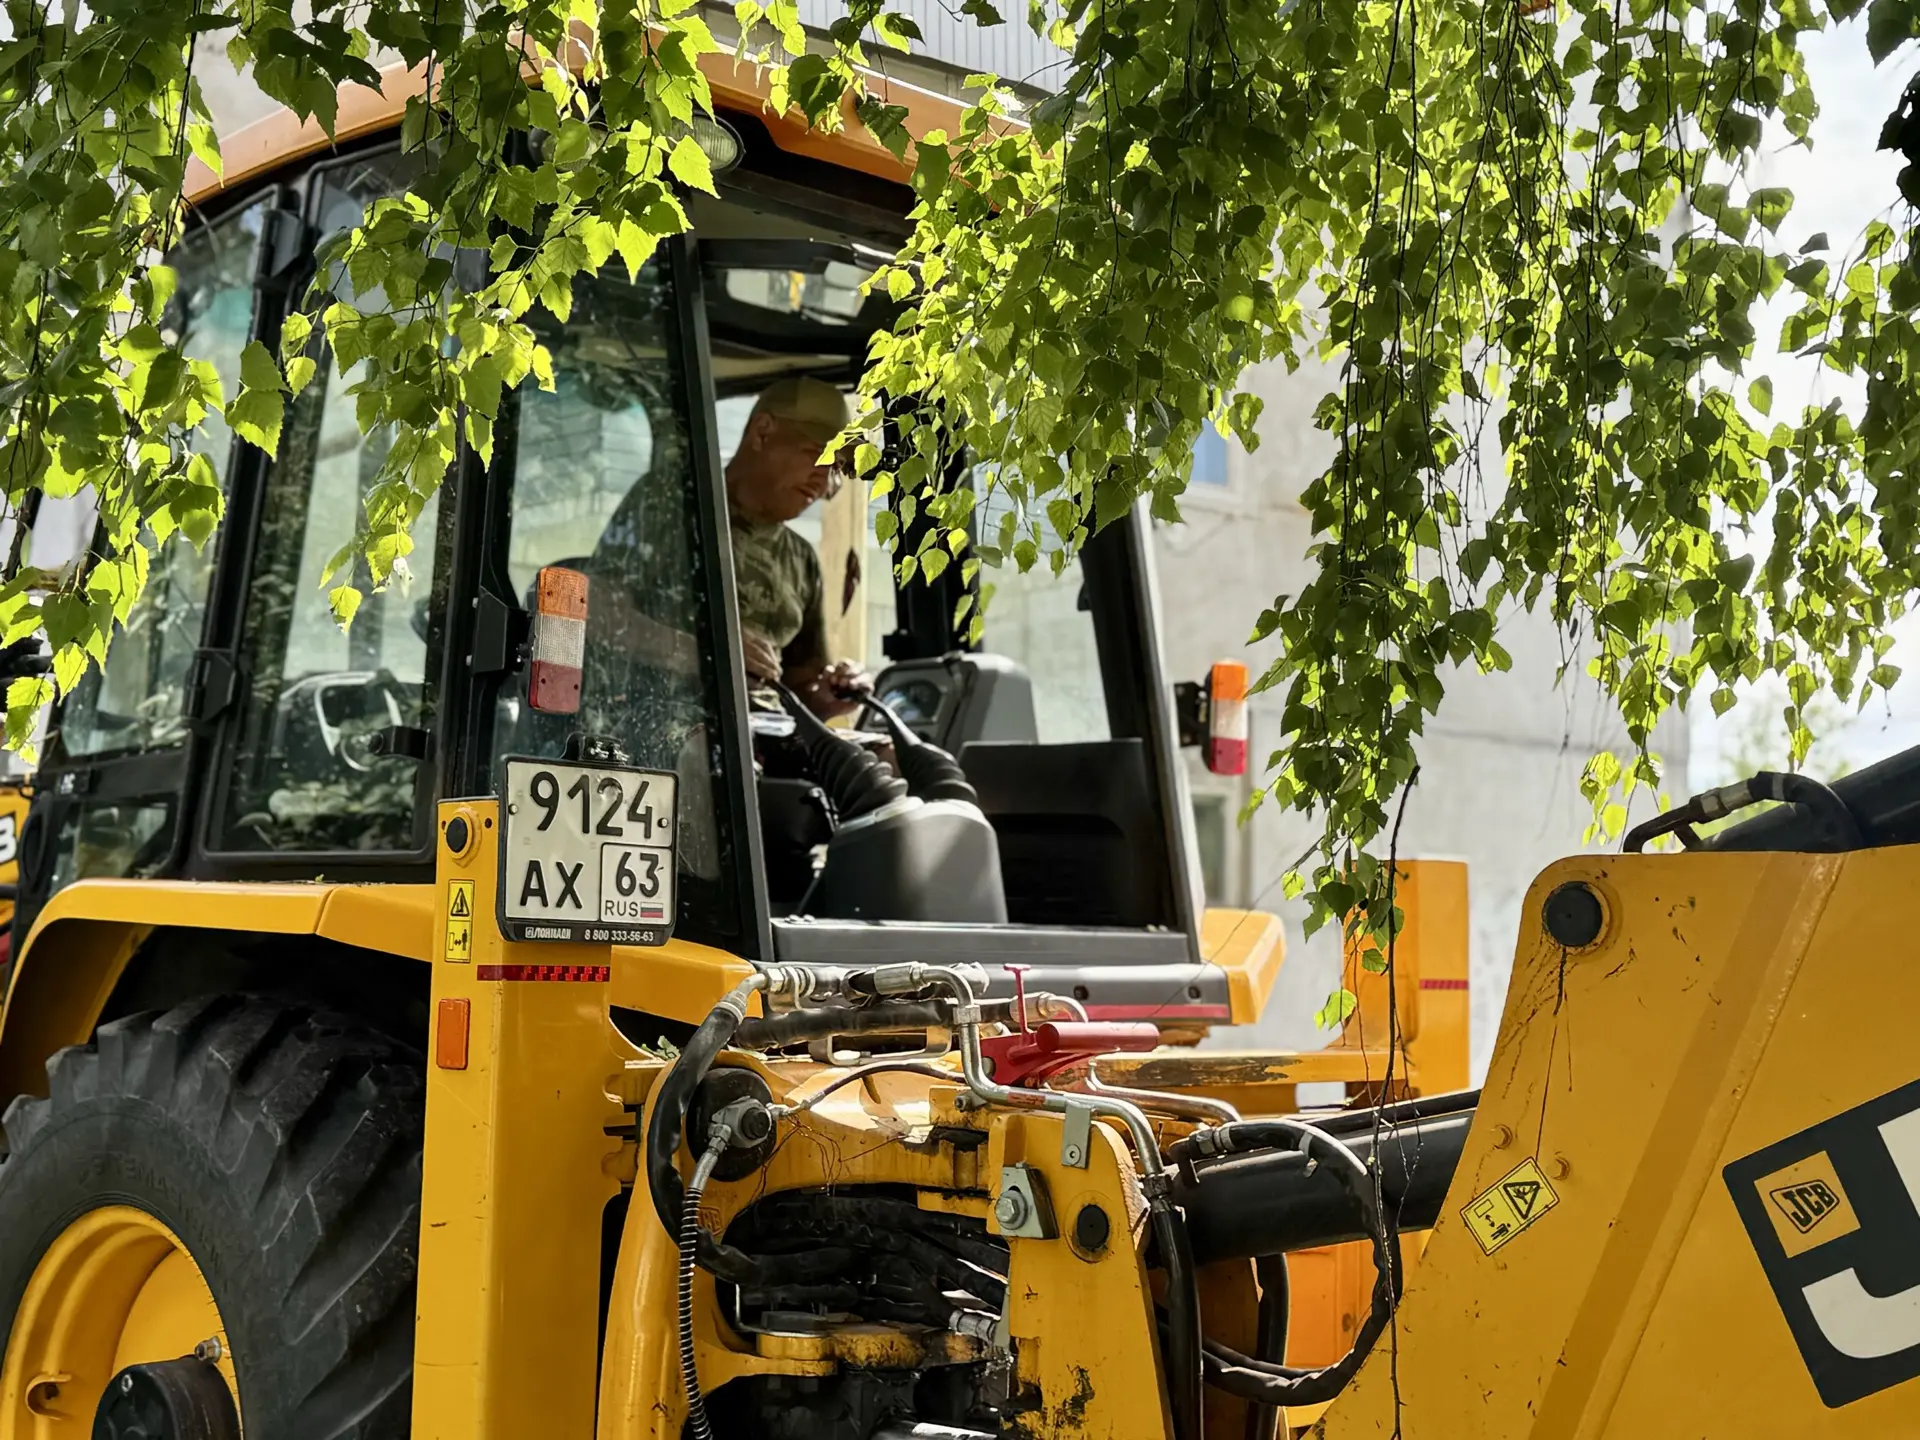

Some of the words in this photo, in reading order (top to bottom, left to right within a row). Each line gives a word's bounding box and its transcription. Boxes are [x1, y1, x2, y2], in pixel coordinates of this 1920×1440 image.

[530, 771, 653, 839] 9124
[616, 852, 660, 898] 63
[604, 900, 639, 917] RUS
[584, 929, 591, 941] 8
[592, 929, 610, 941] 800
[611, 930, 654, 942] 333-56-63
[1781, 1182, 1836, 1228] JCB
